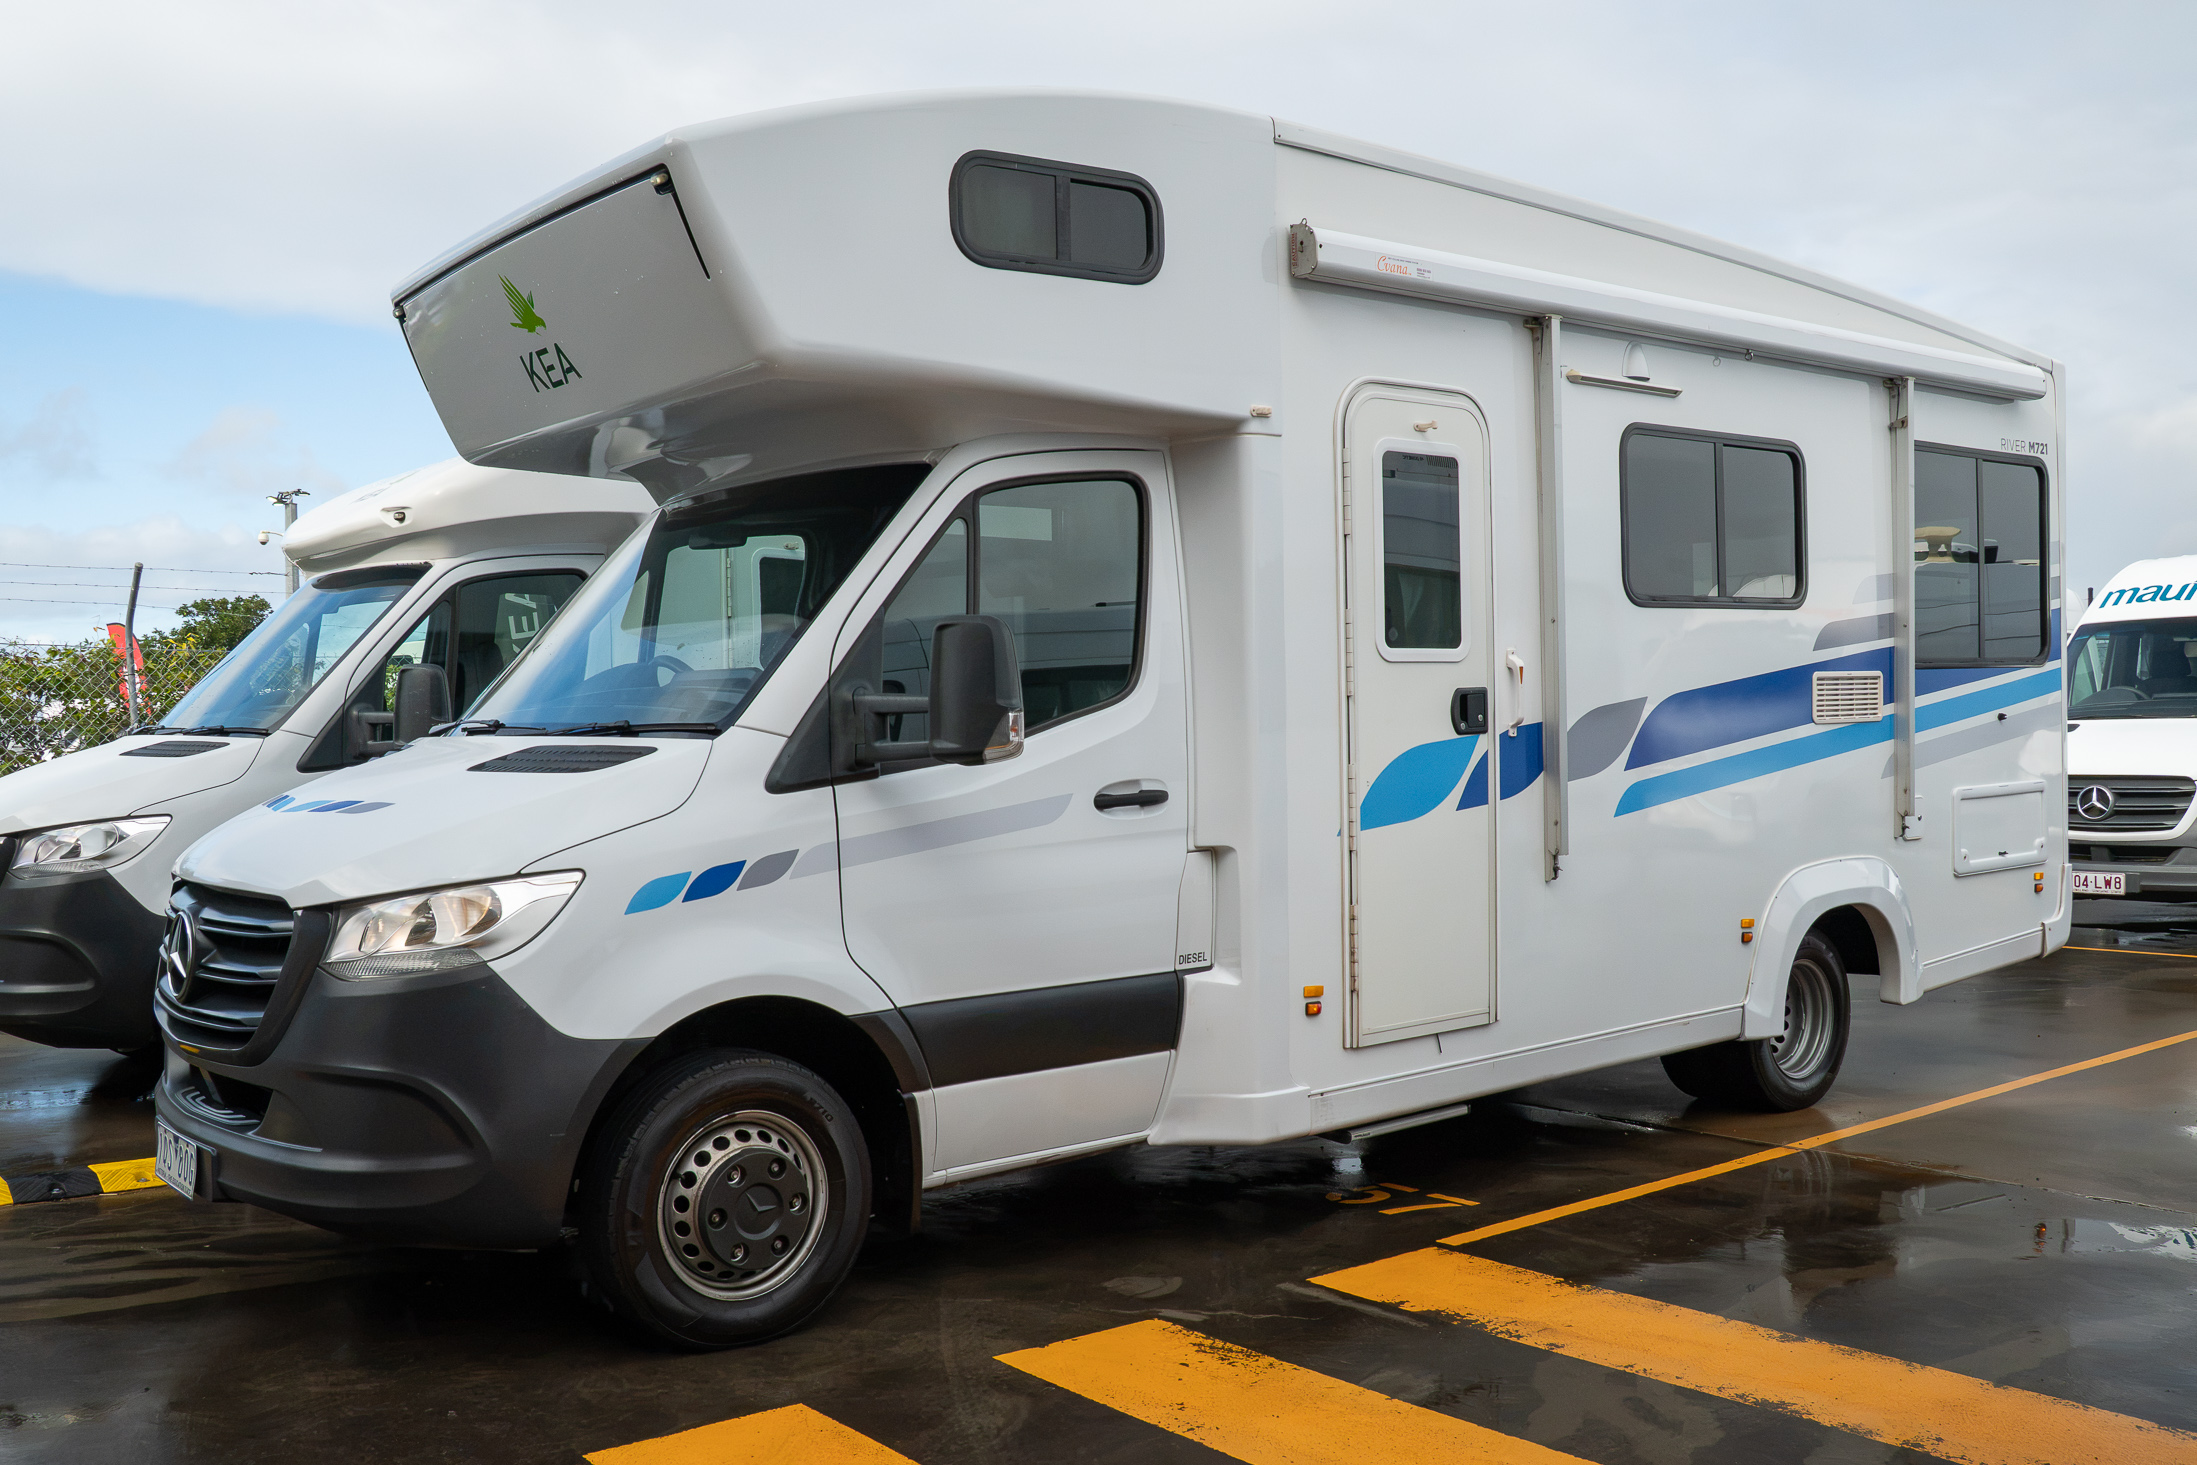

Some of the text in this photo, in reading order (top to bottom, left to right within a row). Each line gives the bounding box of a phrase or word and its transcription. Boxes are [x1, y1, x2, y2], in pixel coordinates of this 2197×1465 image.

[519, 342, 583, 393] KEA
[2000, 437, 2048, 455] RIVER M721
[504, 592, 541, 655] EA
[1178, 951, 1208, 965] DIESEL
